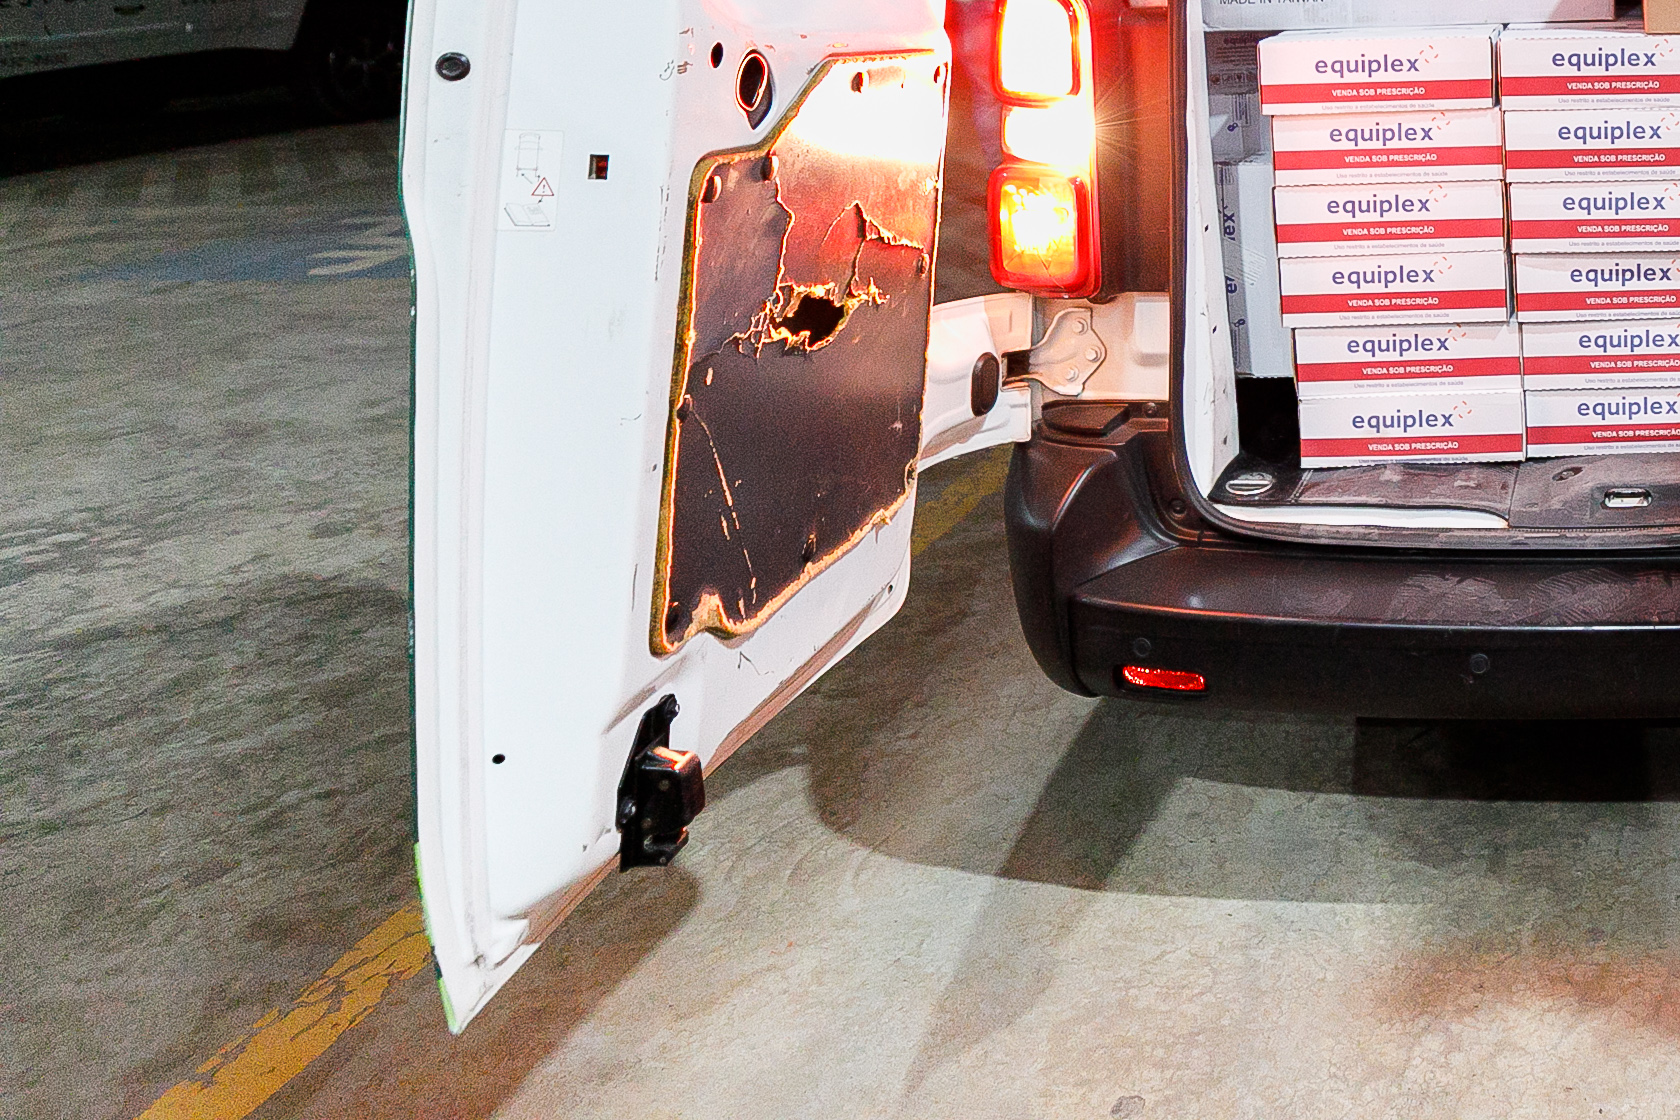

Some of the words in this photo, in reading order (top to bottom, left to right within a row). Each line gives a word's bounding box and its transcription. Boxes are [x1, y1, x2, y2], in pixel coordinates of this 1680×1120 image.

[1315, 54, 1420, 78] equiplex
[1551, 47, 1657, 71] equiplex
[1332, 88, 1358, 97] VENDA
[1359, 88, 1375, 97] SOB
[1377, 87, 1425, 96] PRESCRIÇÃO
[1567, 82, 1593, 90] VENDA
[1594, 81, 1610, 90] SOB
[1612, 80, 1659, 90] PRESCRIÇÃO
[1329, 124, 1433, 146] equiplex
[1557, 121, 1662, 144] equiplex
[1344, 155, 1370, 163] VENDA
[1372, 154, 1388, 163] SOB
[1389, 153, 1437, 163] PRESCRIÇÃO
[1573, 155, 1599, 163] VENDA
[1600, 154, 1616, 163] SOB
[1618, 153, 1665, 163] PRESCRIÇÃO
[1326, 195, 1430, 218] equiplex
[1562, 192, 1666, 215] equiplex
[1343, 227, 1368, 236] VENDA
[1370, 227, 1385, 235] SOB
[1387, 226, 1434, 235] PRESCRIÇÃO
[1577, 225, 1603, 233] VENDA
[1604, 225, 1620, 233] SOB
[1621, 224, 1668, 233] PRESCRIÇÃO
[1331, 265, 1435, 288] equiplex
[1570, 263, 1673, 287] equiplex
[1348, 299, 1373, 307] VENDA
[1374, 298, 1390, 307] SOB
[1392, 297, 1438, 306] PRESCRIÇÃO
[1586, 297, 1611, 305] VENDA
[1613, 296, 1628, 304] SOB
[1629, 295, 1676, 304] PRESCRIÇÃO
[1346, 334, 1450, 357] equiplex
[1578, 329, 1680, 353] equiplex
[1362, 366, 1388, 375] VENDA
[1389, 366, 1404, 375] SOB
[1406, 365, 1453, 374] PRESCRIÇÃO
[1590, 361, 1615, 369] VENDA
[1617, 360, 1632, 368] SOB
[1634, 359, 1680, 368] PRESCRIÇÃO
[1577, 396, 1679, 420] equiplex
[1351, 409, 1454, 433] equiplex
